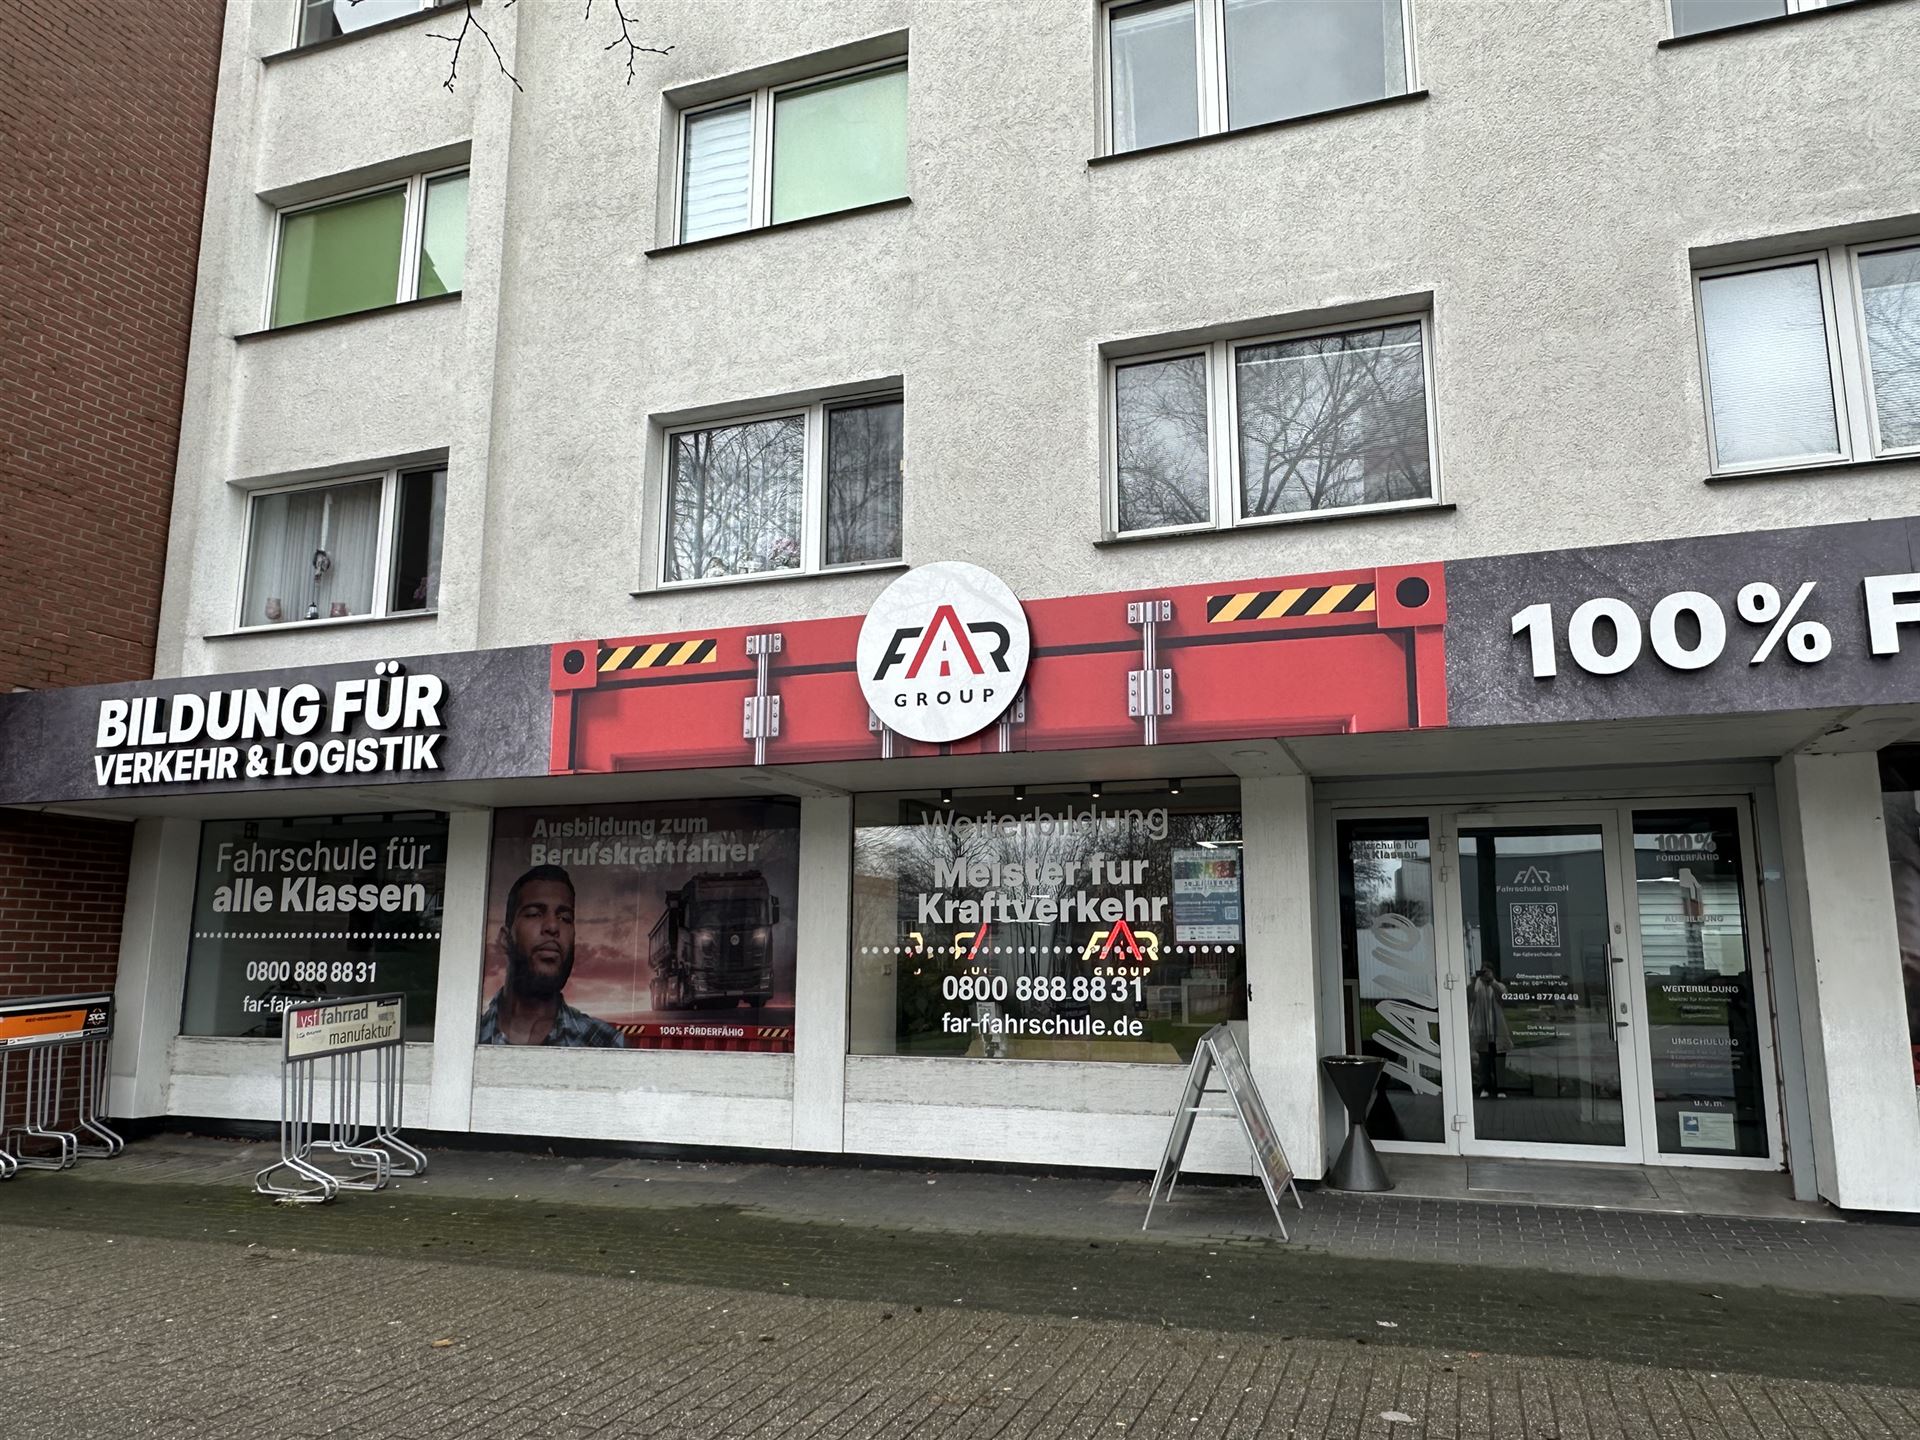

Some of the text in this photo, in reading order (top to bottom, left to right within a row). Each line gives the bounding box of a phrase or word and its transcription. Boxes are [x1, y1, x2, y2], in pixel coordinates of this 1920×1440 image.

[872, 604, 1011, 681] FAR
[1511, 581, 1833, 678] 100%
[95, 660, 443, 748] BILDUNG FÜR
[894, 688, 994, 708] GROUP
[94, 734, 440, 786] VERKEHR & LOGISTIK
[532, 816, 708, 840] Ausbildung zum
[920, 803, 1169, 841] Weiterbildung
[216, 837, 431, 873] Fahrschule für
[530, 839, 760, 867] Berufskraftfahrer
[1654, 832, 1717, 852] 100%
[933, 856, 1081, 888] Meister
[1513, 865, 1551, 884] FAR
[212, 877, 426, 913] alle Klassen
[1543, 884, 1569, 892] GmbH
[918, 889, 1168, 924] Kraftverkehr
[1081, 919, 1159, 961] FAR
[246, 961, 290, 981] 0800
[1093, 966, 1151, 977] GROUP
[942, 975, 1008, 1002] 0800
[1662, 984, 1739, 994] WEITERBILDUNG
[300, 1003, 369, 1030] vsf fahrrad
[941, 1011, 1143, 1037] far-fahrschule.de
[659, 1024, 744, 1037] 100% FÖRDERFÄHIG
[1671, 1037, 1739, 1047] UMSCHULUNG
